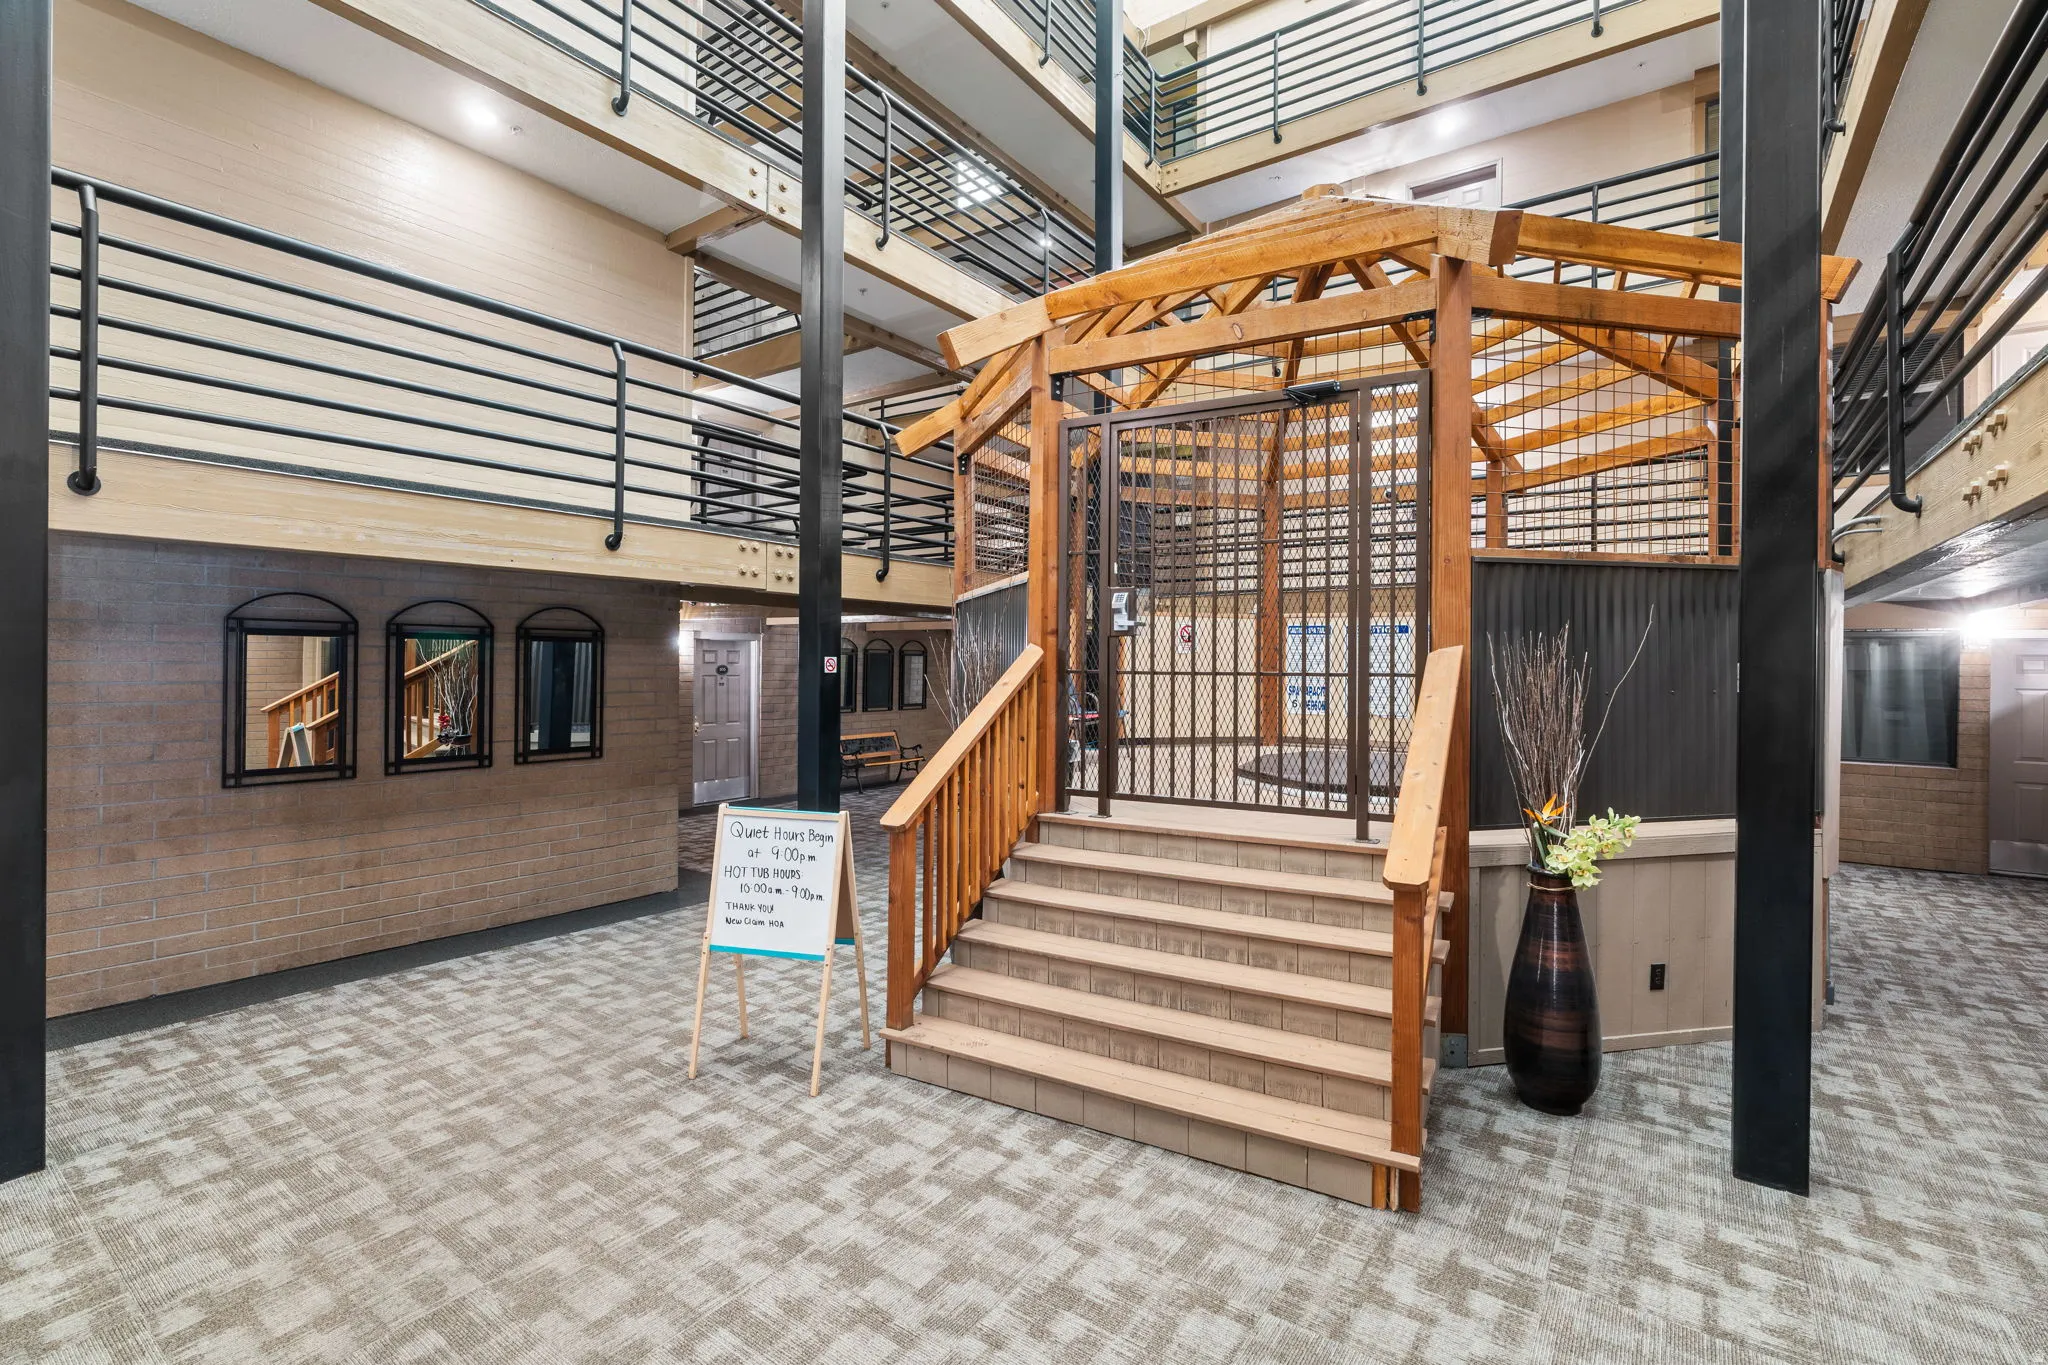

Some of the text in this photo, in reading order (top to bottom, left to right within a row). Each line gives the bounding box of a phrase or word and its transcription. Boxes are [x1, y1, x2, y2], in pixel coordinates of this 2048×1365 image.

[1292, 699, 1298, 708] 6
[730, 821, 834, 848] Quiet Hours Begin
[747, 847, 761, 858] at
[724, 865, 748, 879] HOT
[751, 866, 770, 879] TUB
[725, 901, 755, 912] THANK
[725, 916, 742, 925] New
[768, 919, 785, 928] HOA
